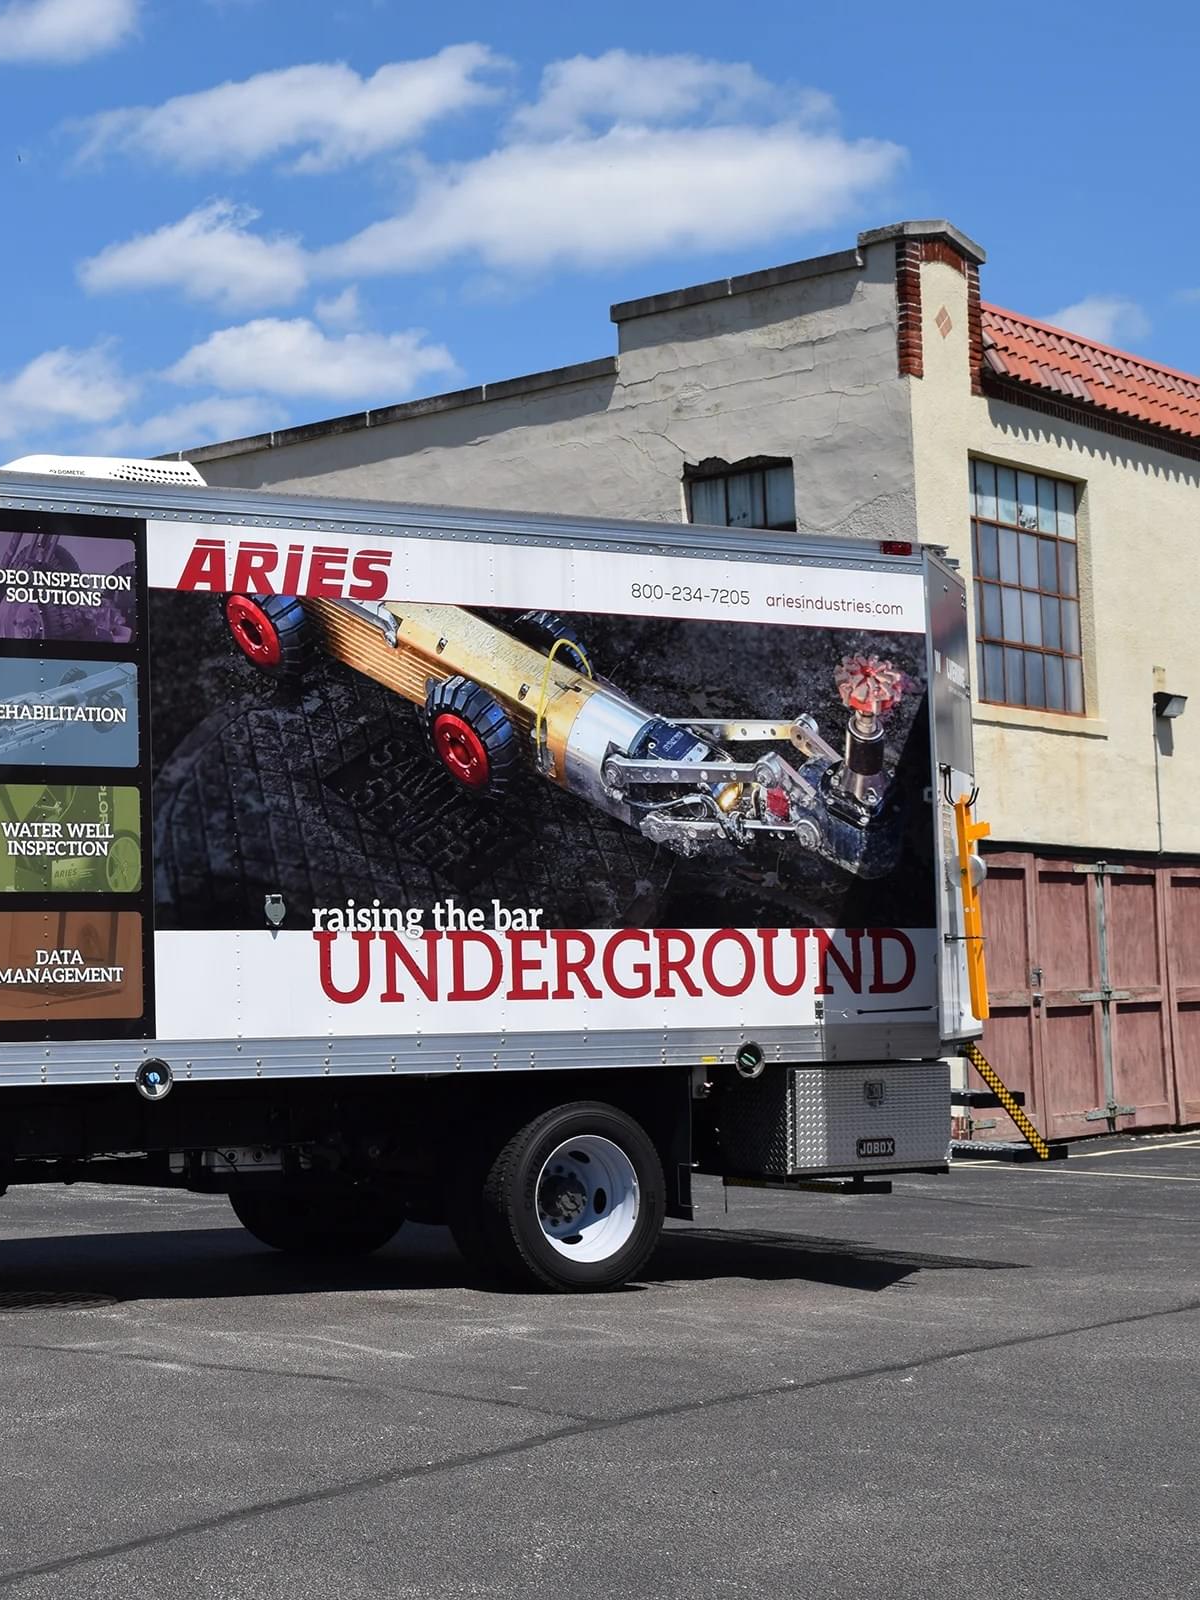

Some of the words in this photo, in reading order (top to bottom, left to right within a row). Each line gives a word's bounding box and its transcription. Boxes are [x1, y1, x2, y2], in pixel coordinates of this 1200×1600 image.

[177, 538, 393, 600] ARIES
[32, 571, 132, 591] INSPECTION
[6, 588, 102, 607] SOLUTIONS
[631, 583, 751, 606] 800-234-7205
[766, 592, 904, 616] ariesindustries.com
[1, 822, 63, 838] WATER
[66, 823, 114, 839] WELL
[7, 840, 109, 857] INSPECTION
[54, 868, 78, 879] ARIES
[312, 903, 424, 938] raising
[432, 900, 485, 931] the
[493, 899, 543, 931] bar
[36, 949, 84, 965] DATA
[313, 928, 916, 1005] UNDERGROUND
[860, 1141, 893, 1155] JOBOX
